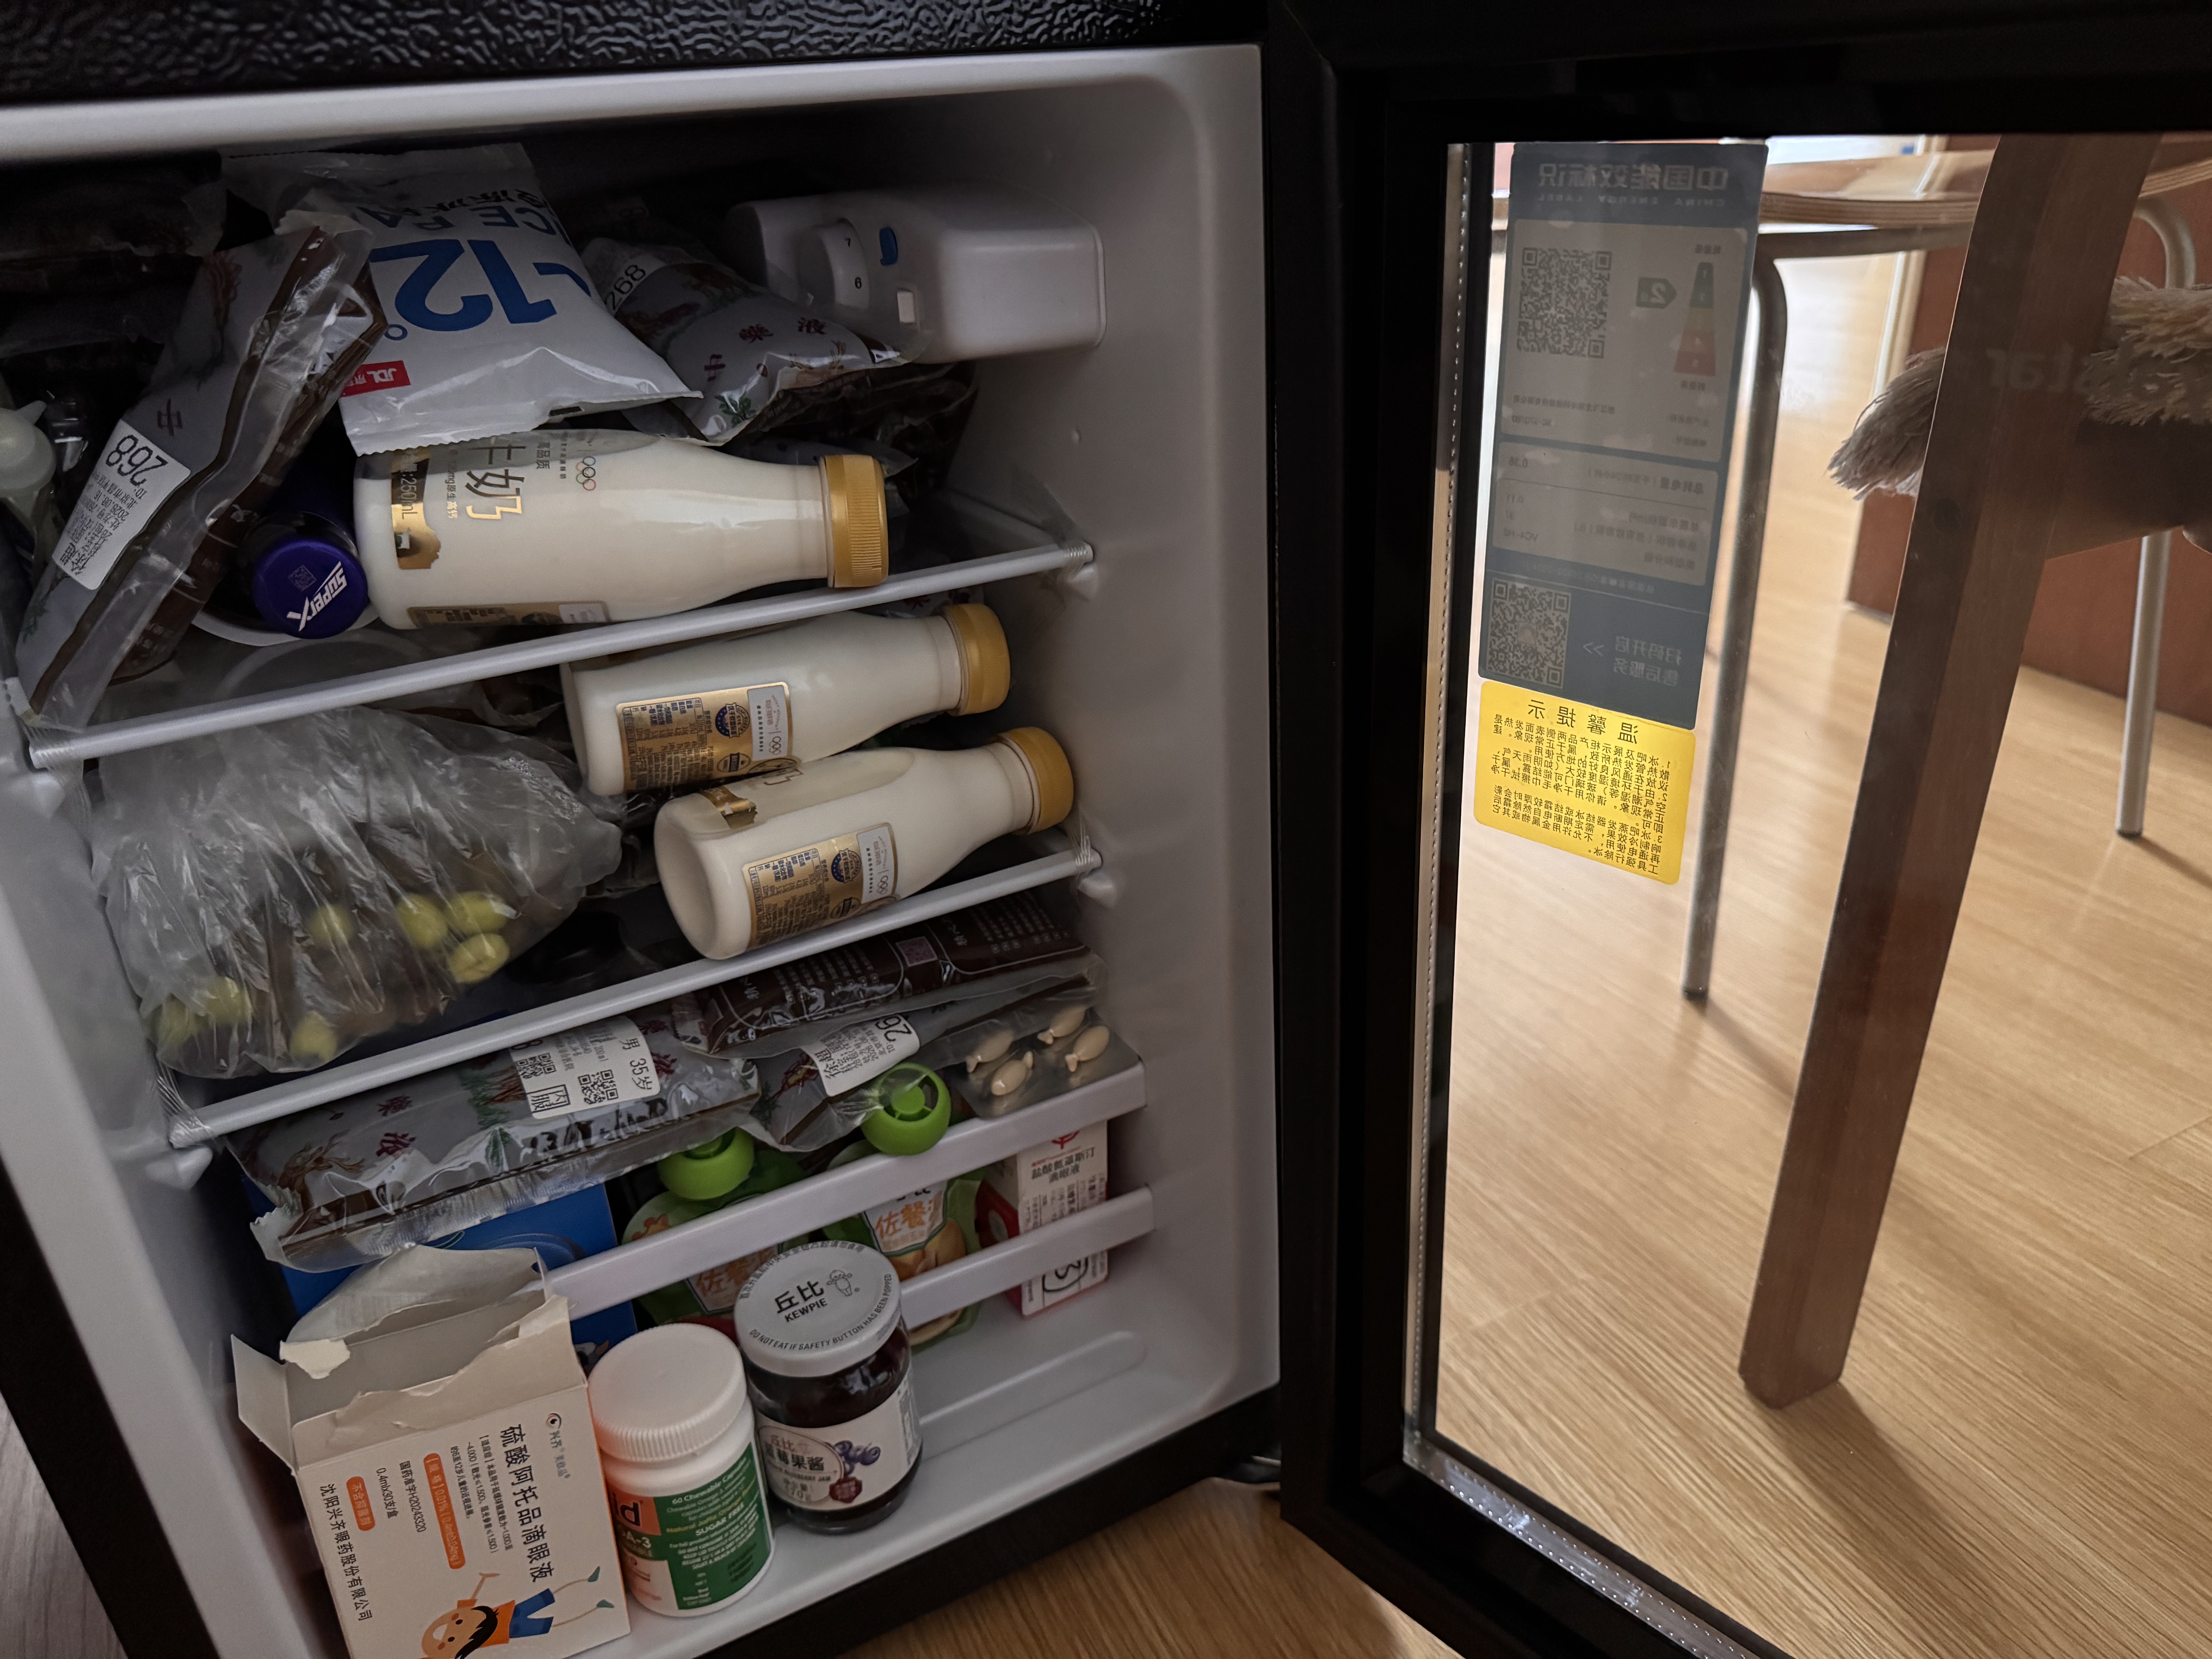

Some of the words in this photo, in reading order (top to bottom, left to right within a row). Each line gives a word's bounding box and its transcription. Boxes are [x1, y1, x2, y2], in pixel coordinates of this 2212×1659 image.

[845, 237, 852, 247] 7
[603, 264, 647, 312] 268
[854, 276, 862, 290] 6
[366, 367, 397, 383] JDL
[103, 430, 168, 494] 268
[57, 541, 93, 576] 徐超
[618, 1034, 641, 1053] 男
[625, 1055, 656, 1095] 35岁
[814, 1047, 841, 1080] 徐超
[529, 1084, 570, 1114] 内服
[749, 1329, 760, 1337] DO
[759, 1334, 774, 1346] NOT
[773, 1340, 789, 1350] EAT
[799, 1339, 830, 1350] SAFETY
[832, 1326, 863, 1344] BUTTON
[864, 1313, 877, 1326] HAS
[875, 1297, 887, 1313] BEEN
[883, 1273, 893, 1298] POPPED
[775, 1281, 825, 1314] 丘比
[785, 1298, 827, 1322] KEWPIE
[398, 1460, 426, 1534] 国药准字H20243320
[498, 1422, 556, 1583] 硫酸阿托品滴眼液
[694, 1515, 727, 1536] SUGAR
[319, 1482, 373, 1622] 沈阳兴齐眼药股份有限公司
